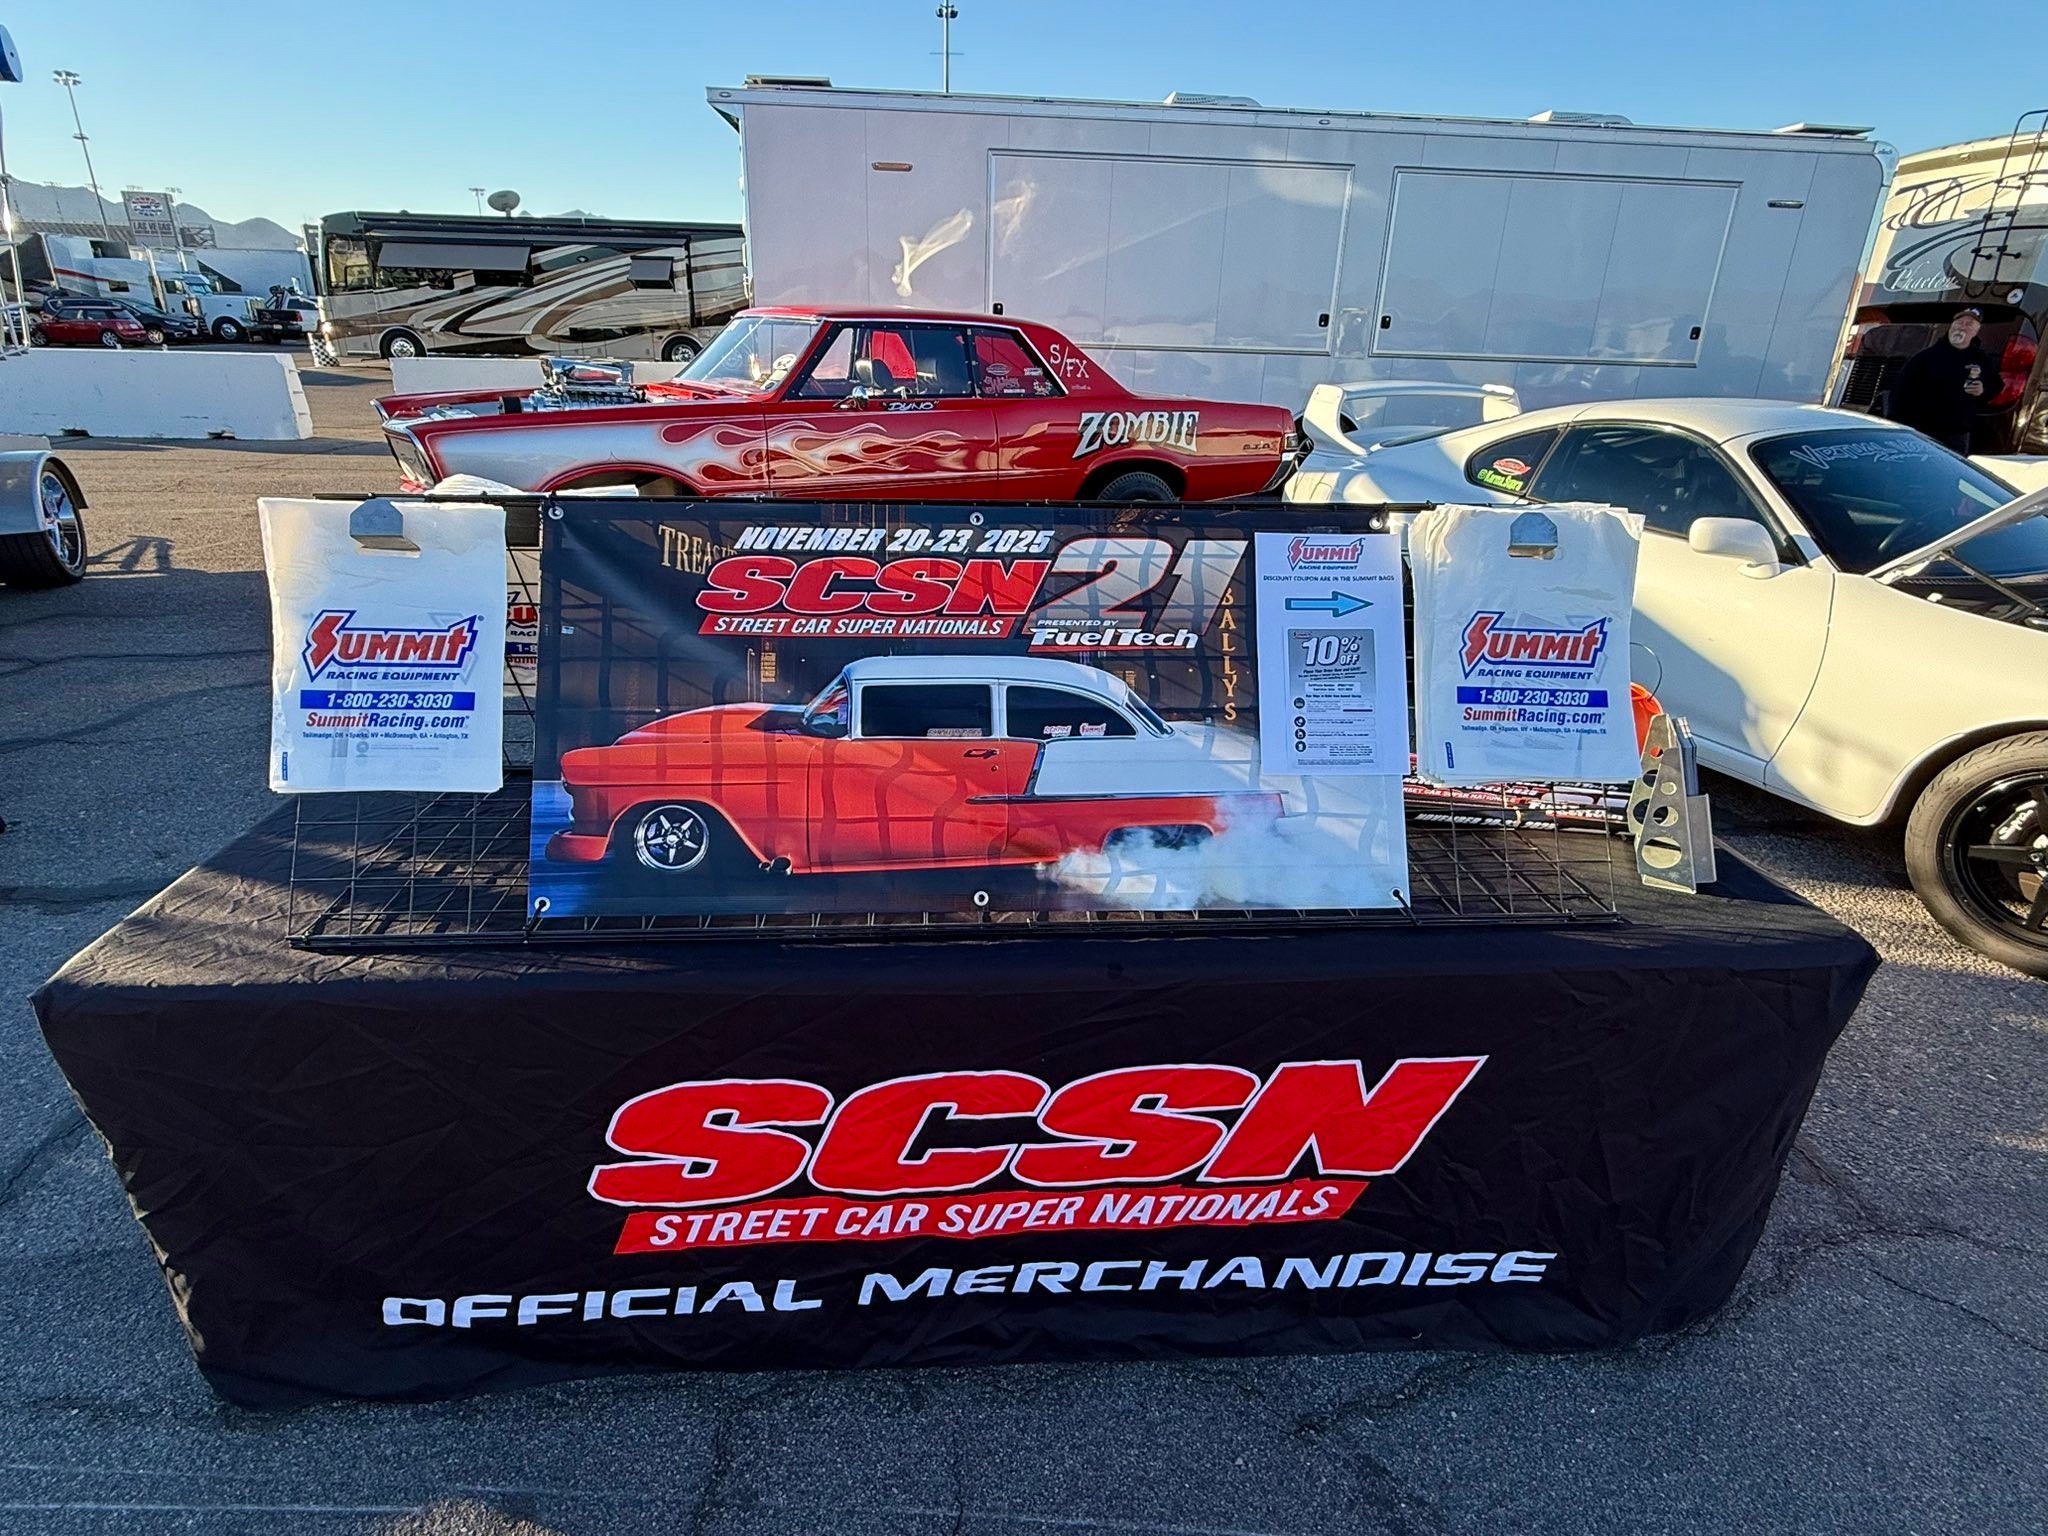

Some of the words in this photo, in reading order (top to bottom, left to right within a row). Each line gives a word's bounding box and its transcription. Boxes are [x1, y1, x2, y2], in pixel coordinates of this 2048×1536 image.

[1891, 260, 1958, 290] Phaeton
[1050, 344, 1089, 378] S/FX
[1072, 410, 1200, 459] ZOMBIE
[733, 527, 886, 550] NOVEMBER
[886, 529, 973, 554] 20-23,
[976, 530, 1055, 552] 2025
[695, 555, 1051, 615] SCSN
[1023, 536, 1249, 636] 21
[714, 617, 791, 633] STREET
[791, 618, 832, 634] CAR
[835, 618, 896, 635] SUPER
[898, 619, 1003, 635] NATIONALS
[1029, 628, 1198, 649] FuelTech
[1340, 654, 1359, 666] OFF
[326, 671, 378, 680] RACING
[382, 672, 460, 681] EQUIPMENT
[1477, 669, 1522, 678] RACING
[1525, 670, 1593, 680] EQUIPMENT
[327, 693, 453, 708] 1-800-230-3030
[1479, 690, 1590, 705] 1-800-230-3030
[306, 712, 466, 730] SummitRacing.com
[1463, 707, 1603, 725] SummitRacing.com
[587, 1055, 1489, 1207] SCSN
[649, 1207, 828, 1246] STREET
[834, 1203, 929, 1236] CAR
[937, 1198, 1079, 1234] SUPER
[1089, 1186, 1338, 1226] NATIONALS
[382, 1280, 822, 1328] OFFICIAL
[858, 1251, 1557, 1306] MERCHANDISE
